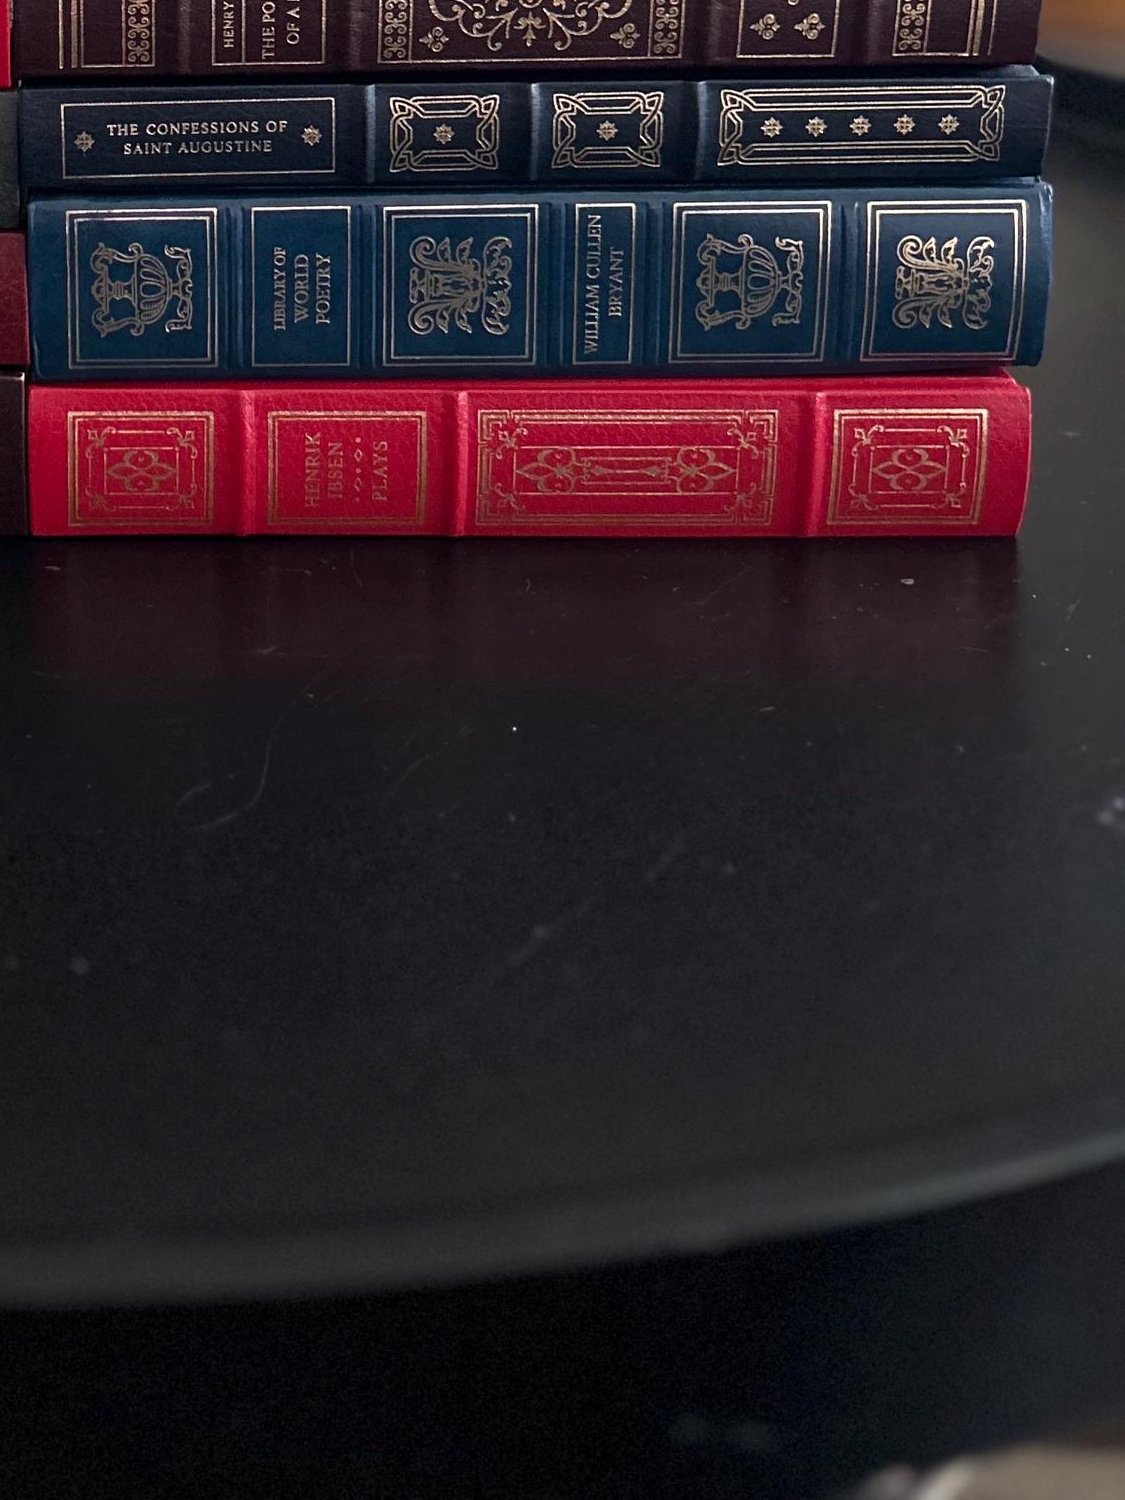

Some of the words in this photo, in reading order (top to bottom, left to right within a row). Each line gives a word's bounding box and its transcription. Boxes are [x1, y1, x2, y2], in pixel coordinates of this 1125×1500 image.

[223, 1, 235, 48] HENRY
[286, 6, 300, 19] A
[286, 22, 300, 45] OF
[262, 27, 275, 60] THE
[106, 123, 138, 136] THE
[146, 121, 259, 136] CONFESSIONS
[265, 120, 288, 133] OF
[123, 142, 172, 155] SAINT
[177, 139, 273, 154] AUGUSTINE
[273, 246, 286, 266] OF
[586, 214, 602, 279] CULLEN
[274, 268, 286, 331] LIBRARY
[294, 254, 310, 324] WORLD
[315, 252, 331, 324] POETRY
[608, 246, 624, 317] BRYANT
[584, 284, 600, 354] WILLIAM
[305, 432, 322, 508] HENRIK
[327, 441, 344, 499] IBSEN
[372, 440, 388, 501] PLAYS
